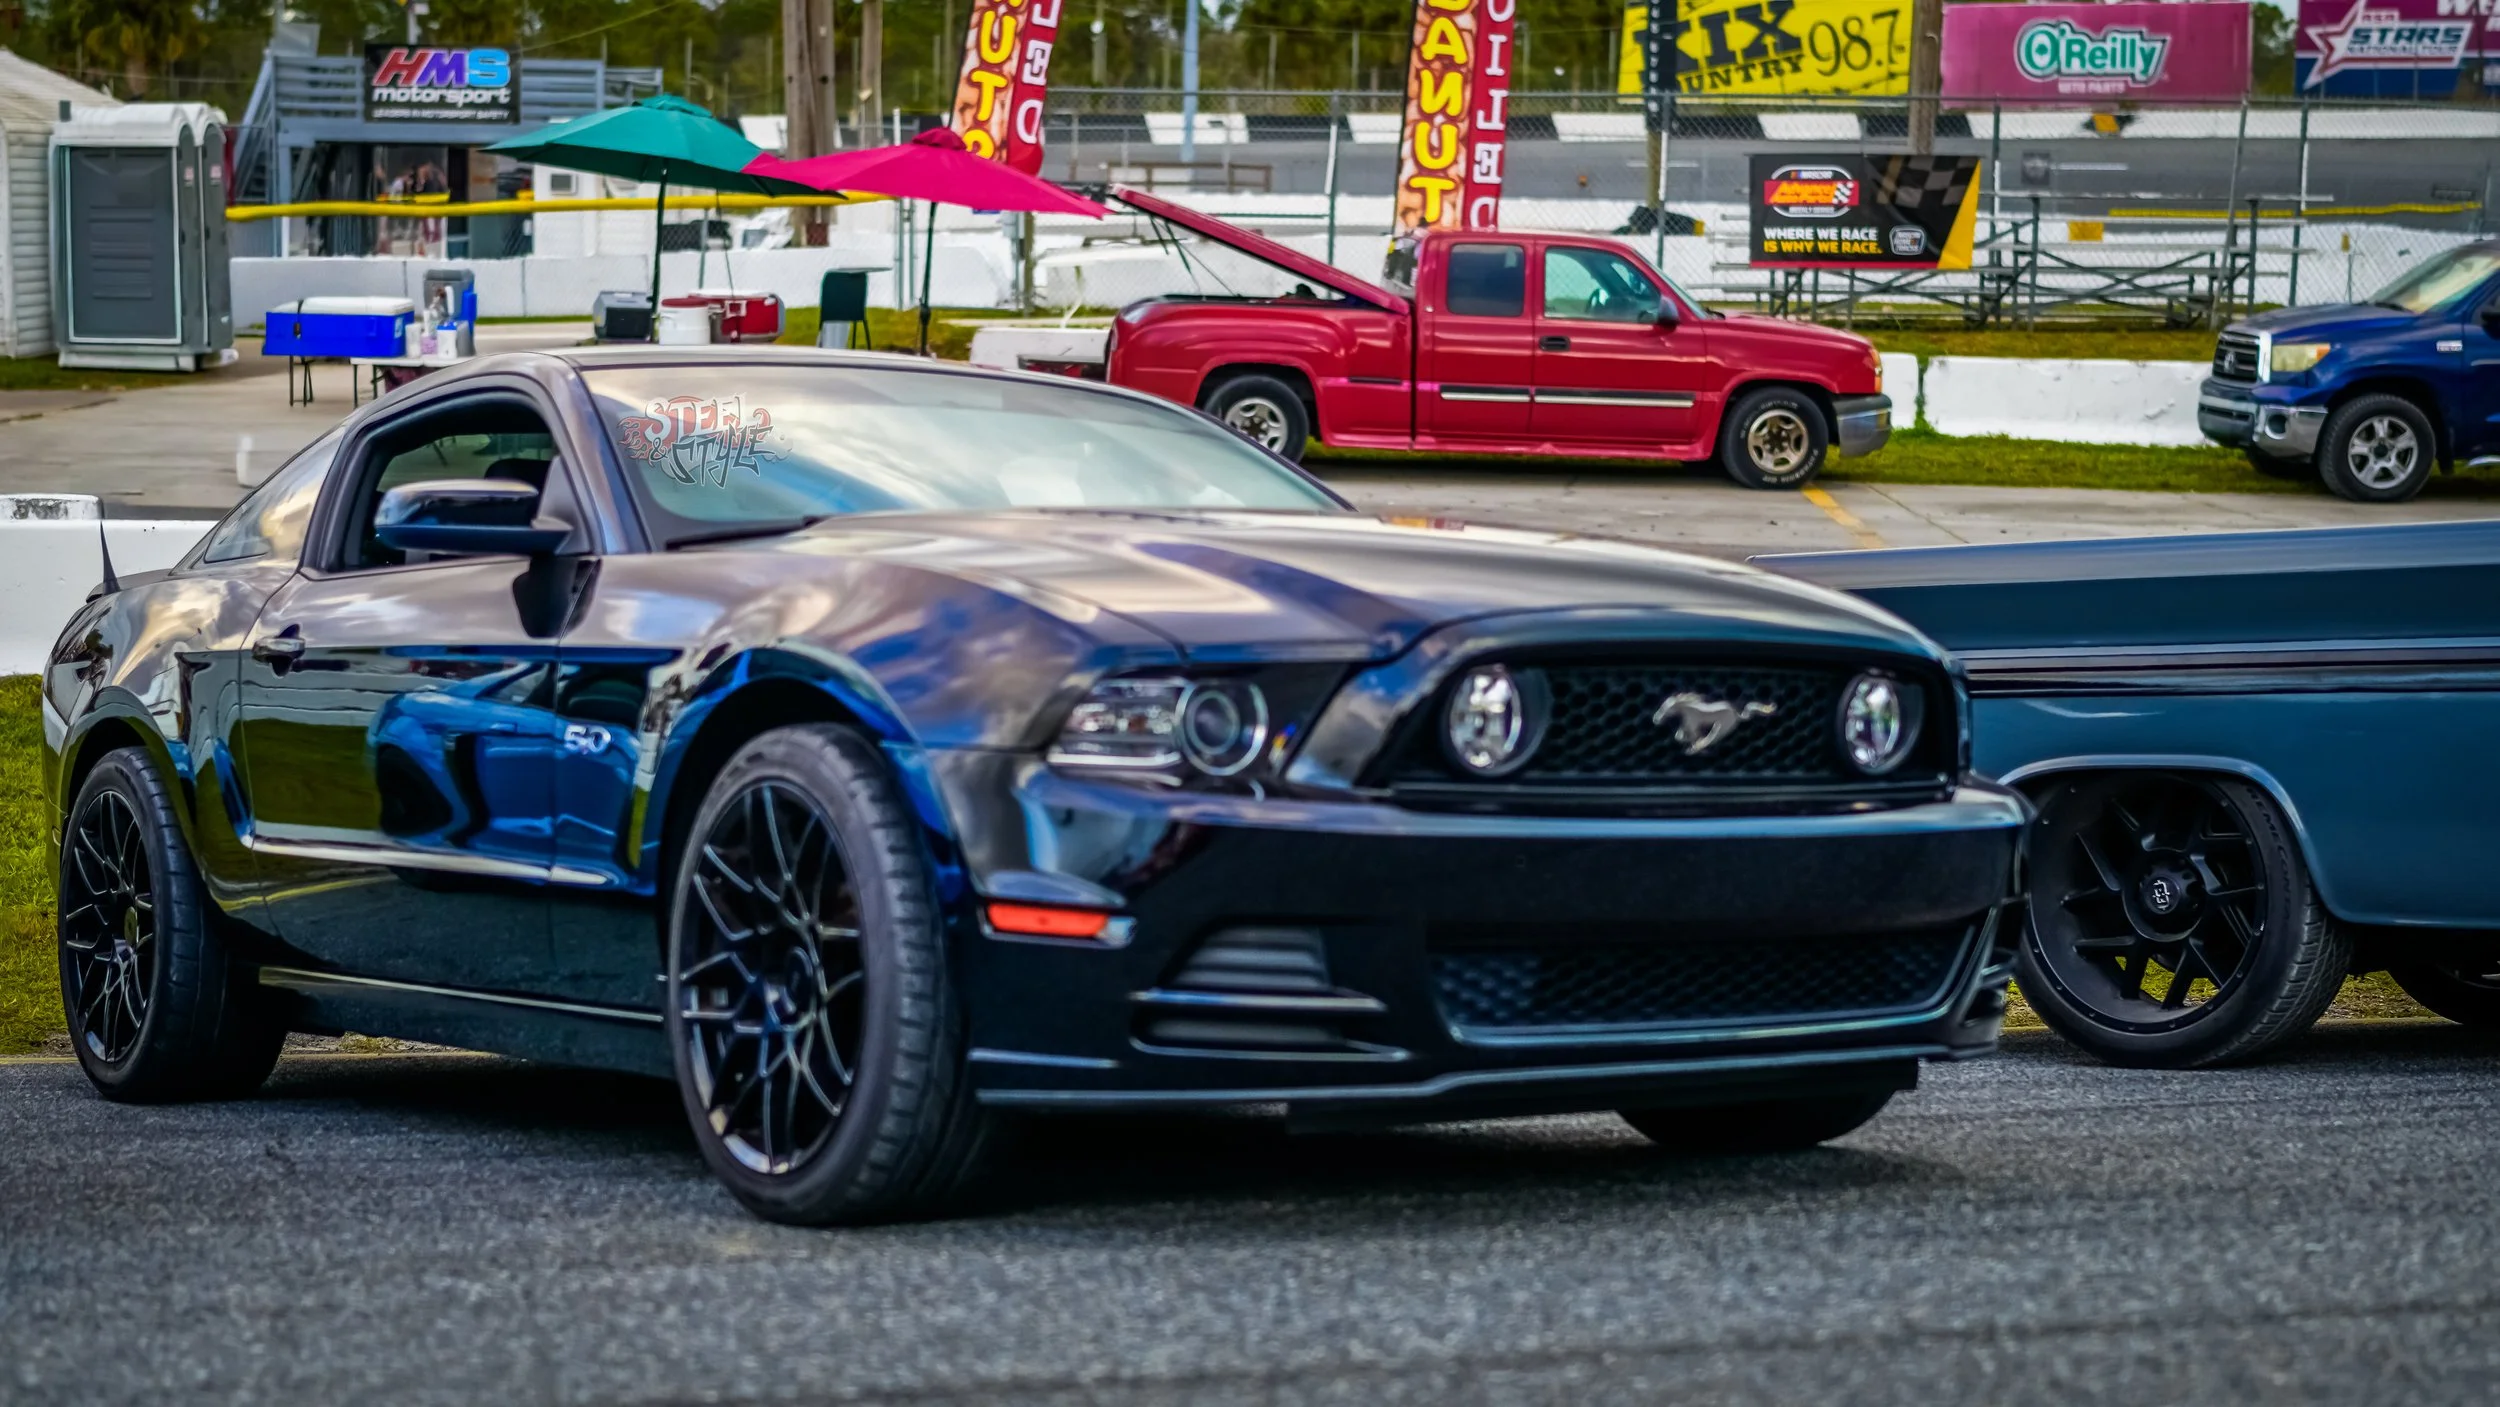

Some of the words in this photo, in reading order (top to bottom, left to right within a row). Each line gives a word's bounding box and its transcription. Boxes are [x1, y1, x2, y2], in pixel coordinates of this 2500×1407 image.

[1807, 8, 1901, 77] 98.7
[2350, 27, 2465, 45] STARS
[372, 47, 512, 88] HMS
[2024, 27, 2158, 77] O'Reilly
[1676, 53, 1804, 93] UNTRY
[373, 86, 512, 109] motorsport
[1763, 227, 1815, 240] WHERE
[1816, 227, 1839, 240] WE
[1841, 227, 1877, 240] RACE
[1763, 241, 1778, 253] IS
[1780, 241, 1815, 253] WHY
[1817, 241, 1840, 253] WE
[1841, 241, 1884, 254] RACE.
